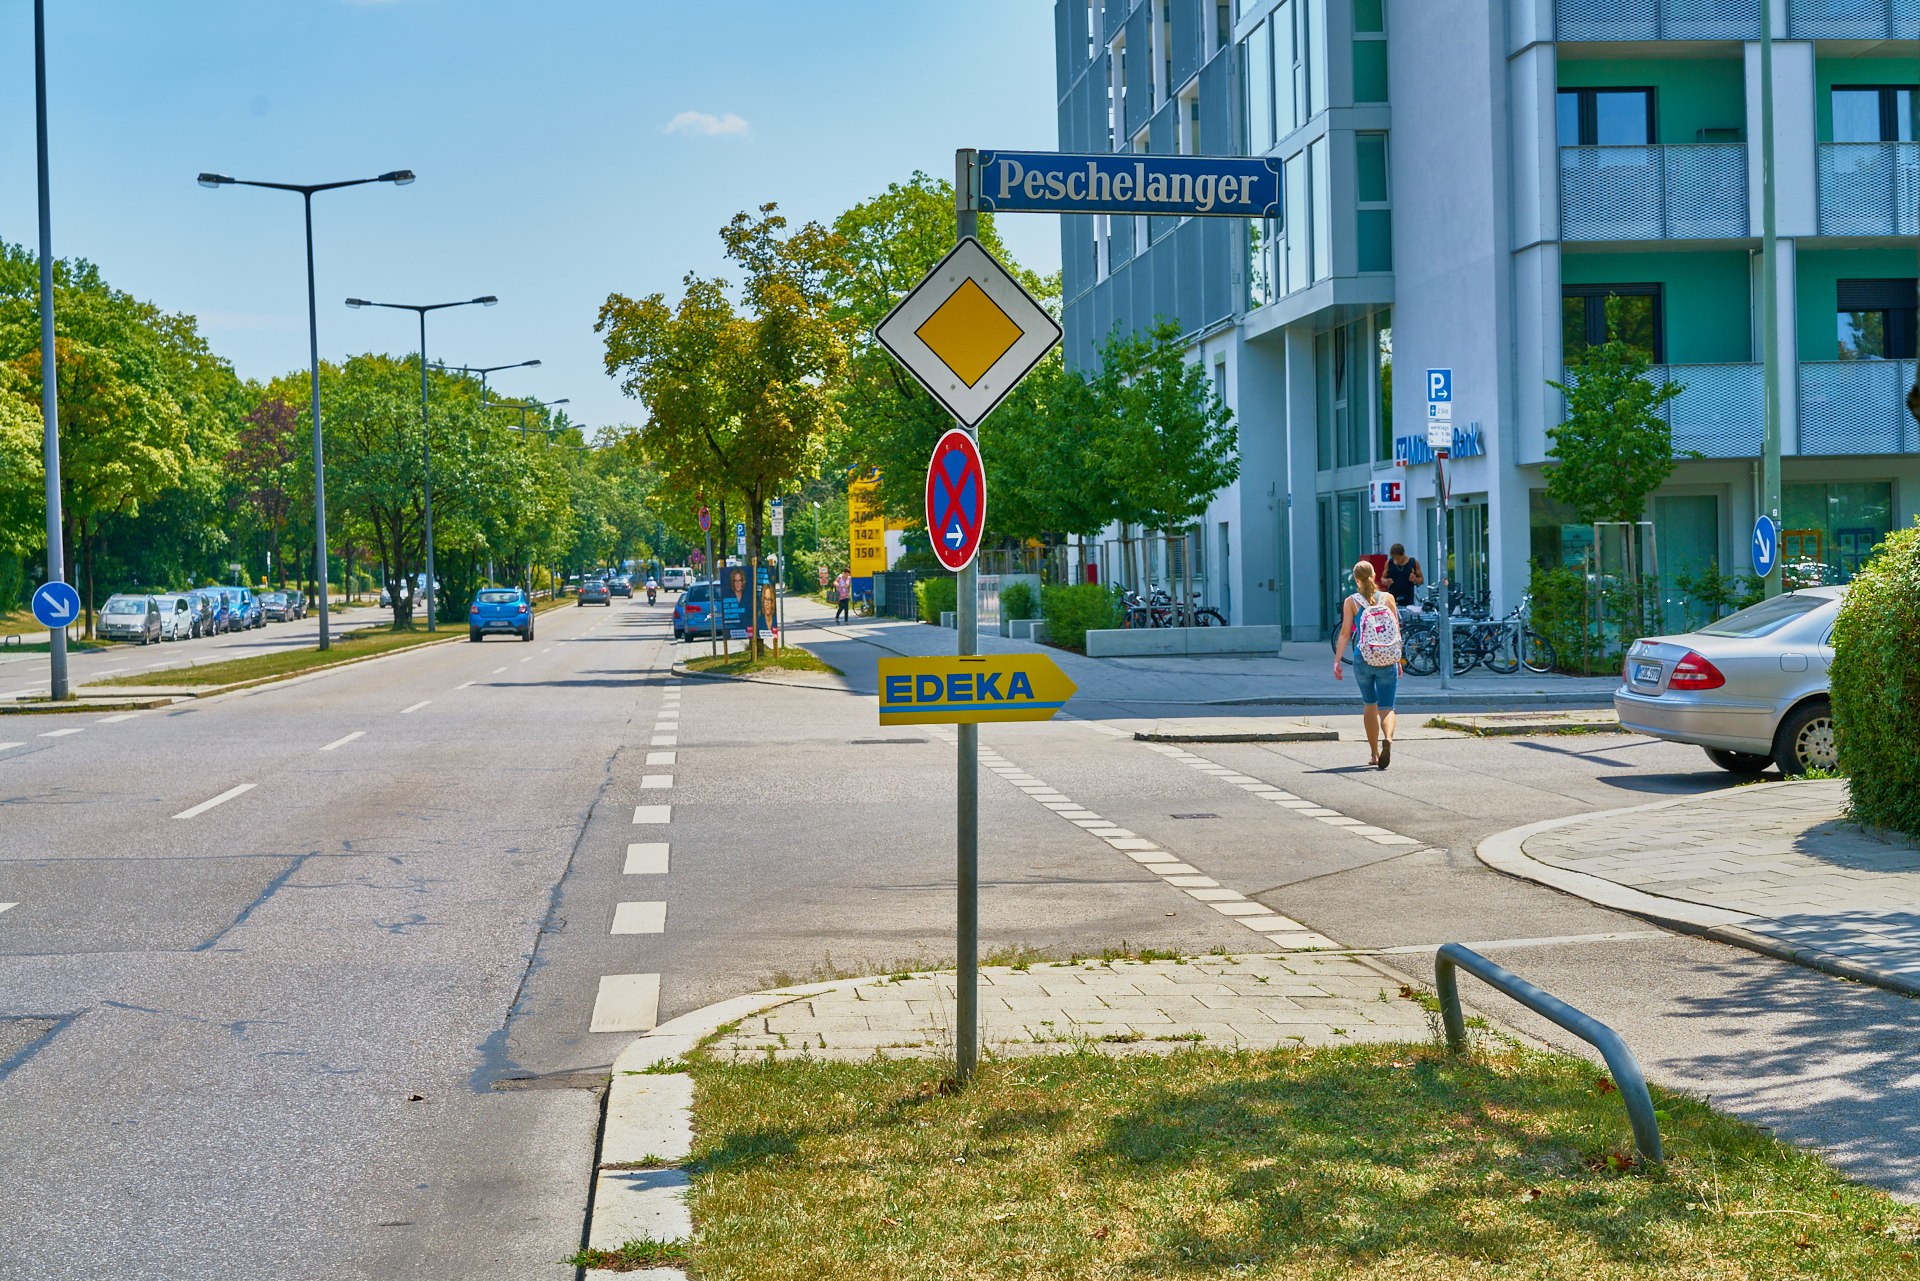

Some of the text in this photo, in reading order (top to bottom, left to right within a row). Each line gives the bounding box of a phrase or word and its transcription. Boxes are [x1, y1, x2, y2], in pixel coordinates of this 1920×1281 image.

[998, 159, 1259, 212] Peschelanger
[1430, 373, 1445, 399] P
[1454, 422, 1480, 459] Bank
[855, 529, 873, 540] 142
[855, 548, 874, 558] 150
[886, 671, 1035, 704] EDEKA
